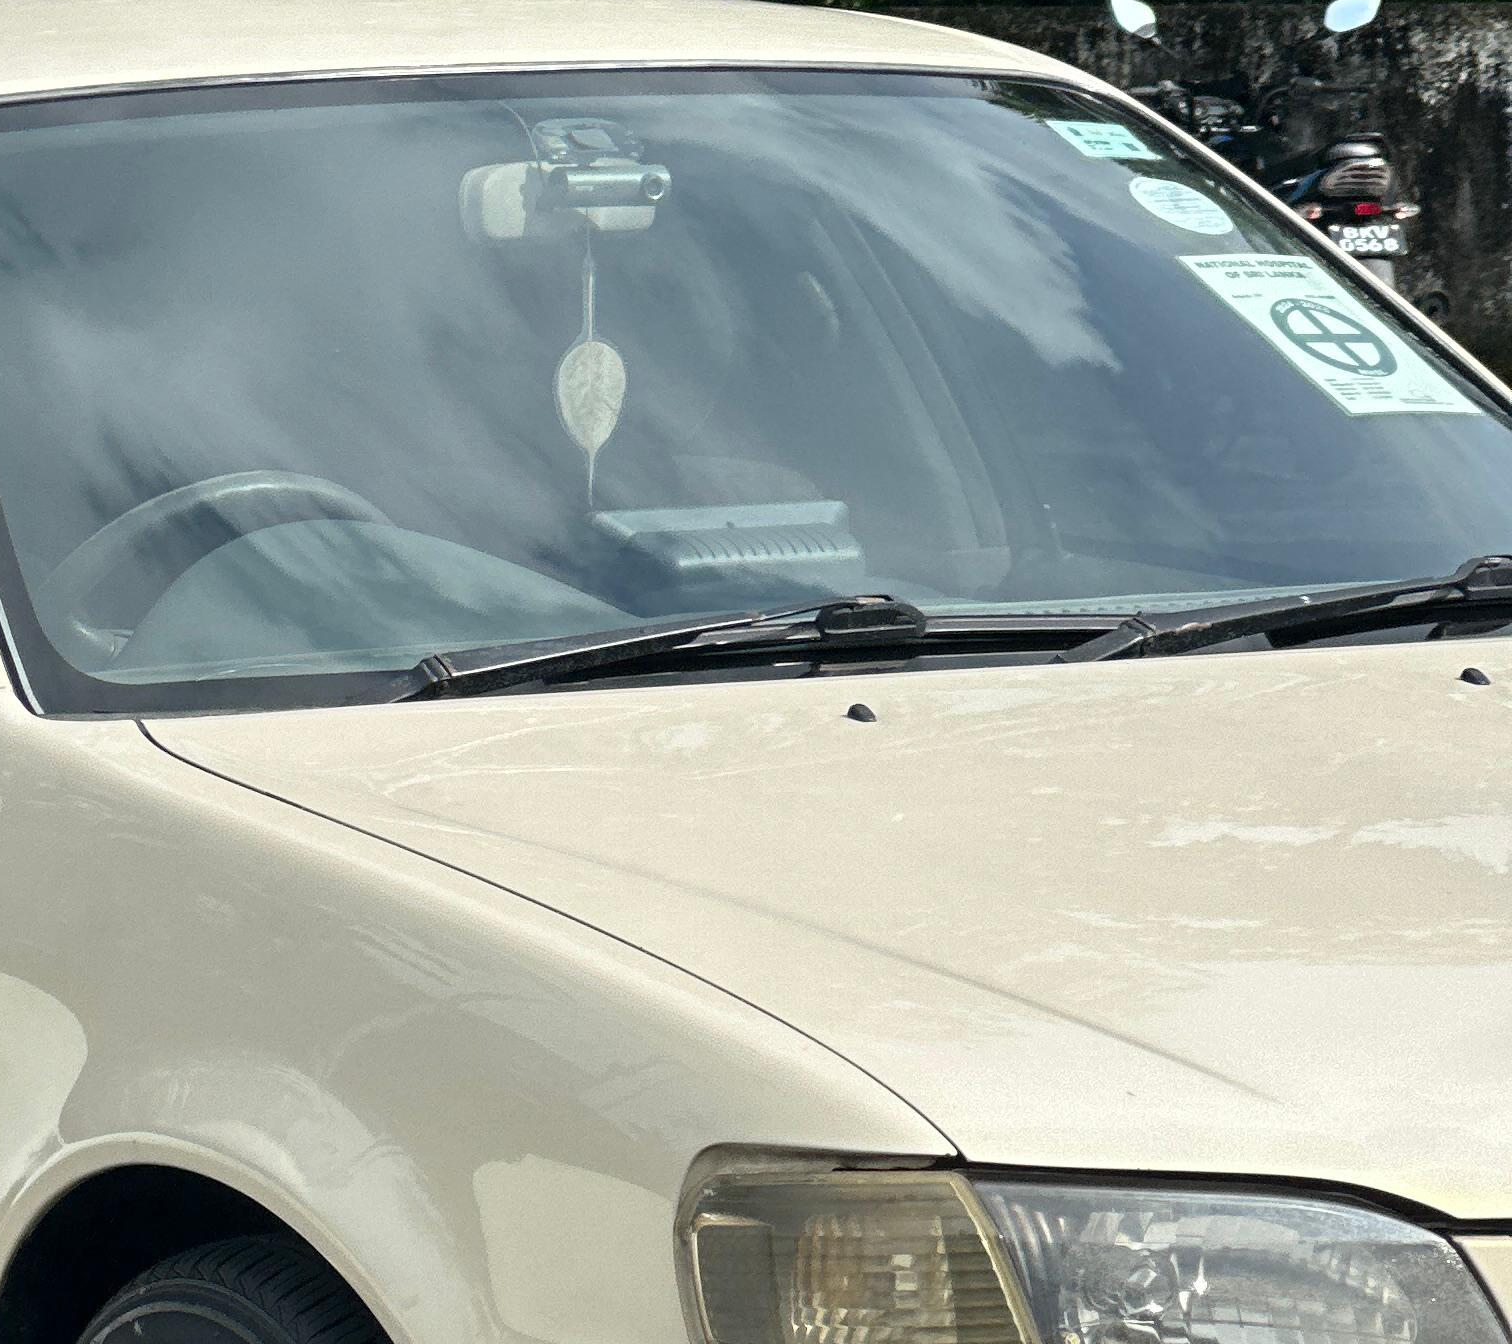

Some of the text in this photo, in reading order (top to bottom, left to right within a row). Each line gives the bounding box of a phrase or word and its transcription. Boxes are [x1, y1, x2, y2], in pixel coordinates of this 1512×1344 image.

[1342, 225, 1389, 239] BKV
[1338, 238, 1399, 252] 0568
[1194, 260, 1313, 269] NATIONAL HOSPITAL
